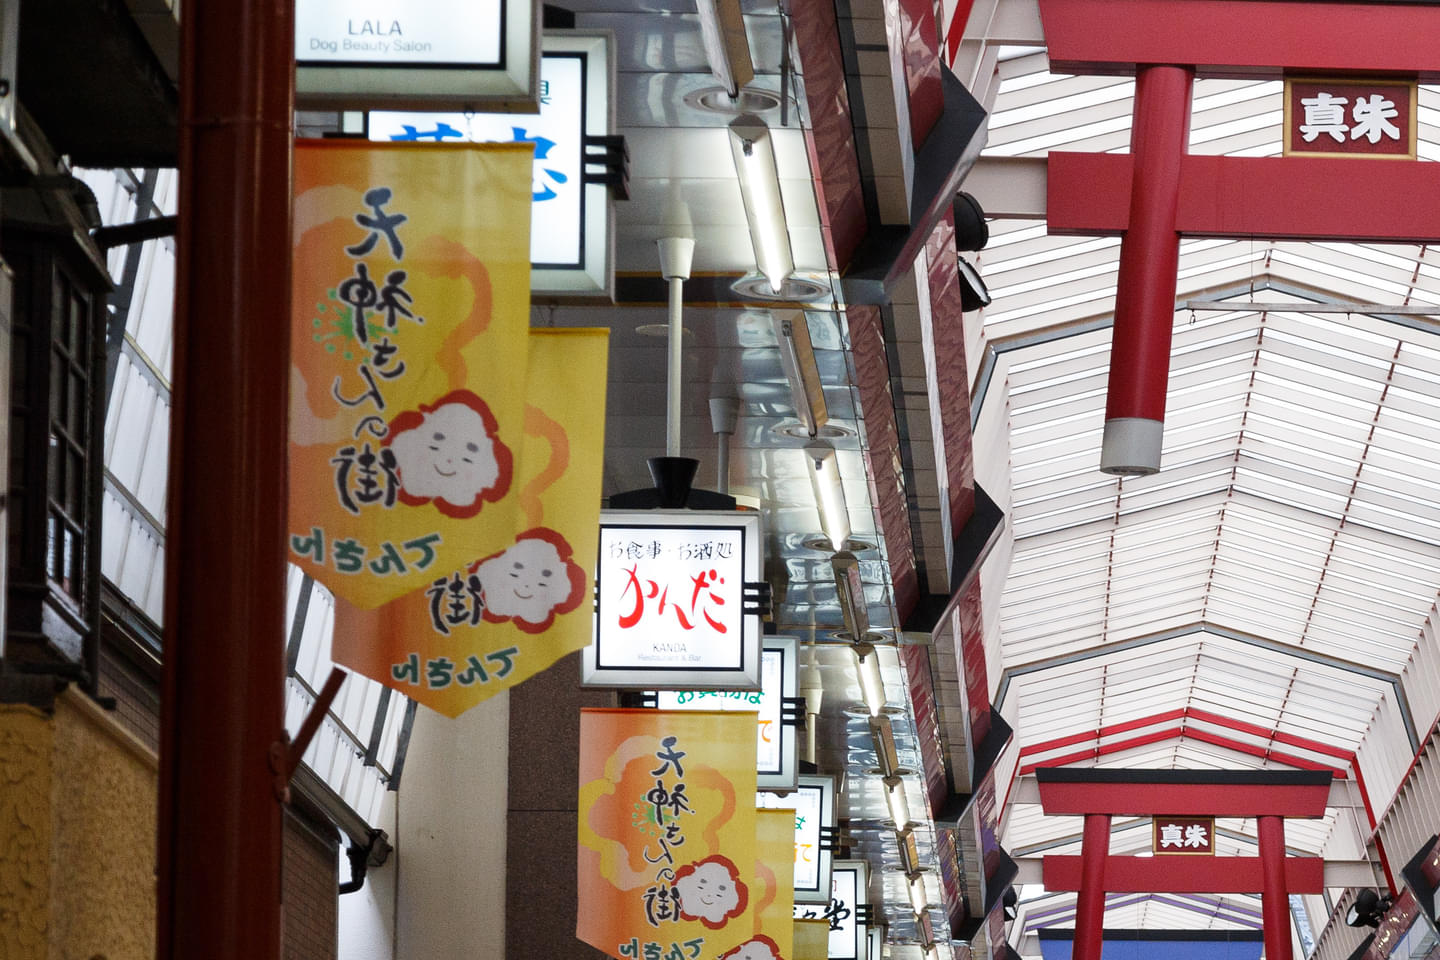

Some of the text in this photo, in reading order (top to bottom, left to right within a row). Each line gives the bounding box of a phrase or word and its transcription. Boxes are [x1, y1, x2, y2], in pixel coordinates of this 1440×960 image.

[347, 19, 403, 36] LALA
[309, 38, 432, 53] Dog Beauty Salon
[1299, 91, 1401, 145] 真朱
[617, 563, 728, 635] かんだ
[652, 642, 688, 654] KANDA
[1159, 823, 1210, 849] 真朱
